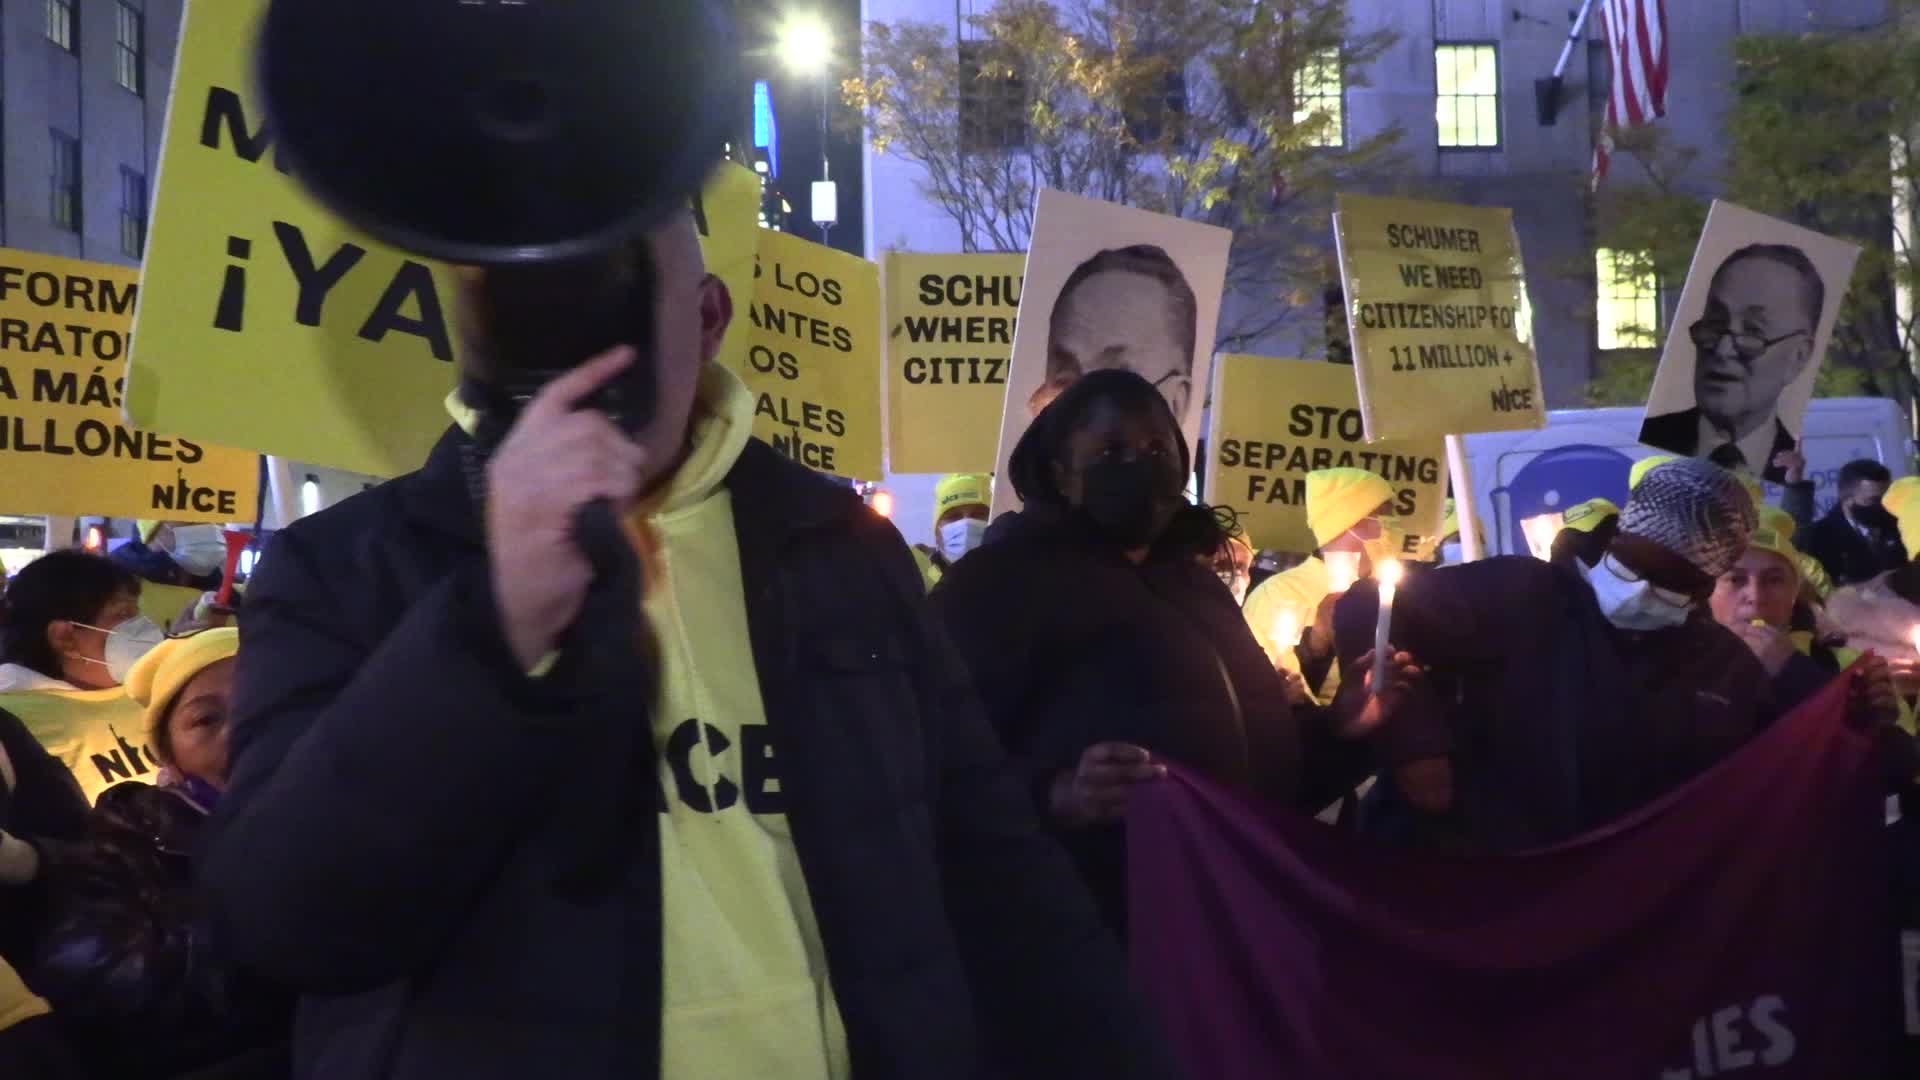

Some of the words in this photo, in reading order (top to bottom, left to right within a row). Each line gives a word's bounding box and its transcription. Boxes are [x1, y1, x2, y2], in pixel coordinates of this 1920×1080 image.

[1387, 223, 1480, 253] SCHUMER
[775, 262, 842, 305] LOS
[1398, 264, 1432, 288] WE
[1435, 265, 1482, 290] NEED
[1361, 303, 1485, 328] CITIZENSHIP
[1, 318, 132, 361] RATO
[1389, 346, 1416, 371] 11
[1419, 345, 1499, 368] MILLION
[904, 357, 1010, 385] CITIZ
[1491, 376, 1533, 412] NICE
[772, 427, 835, 470] NICE
[1219, 439, 1438, 484] SEPARATING
[152, 468, 236, 514] NICE
[657, 718, 783, 814] CE
[1661, 994, 1796, 1080] IES
